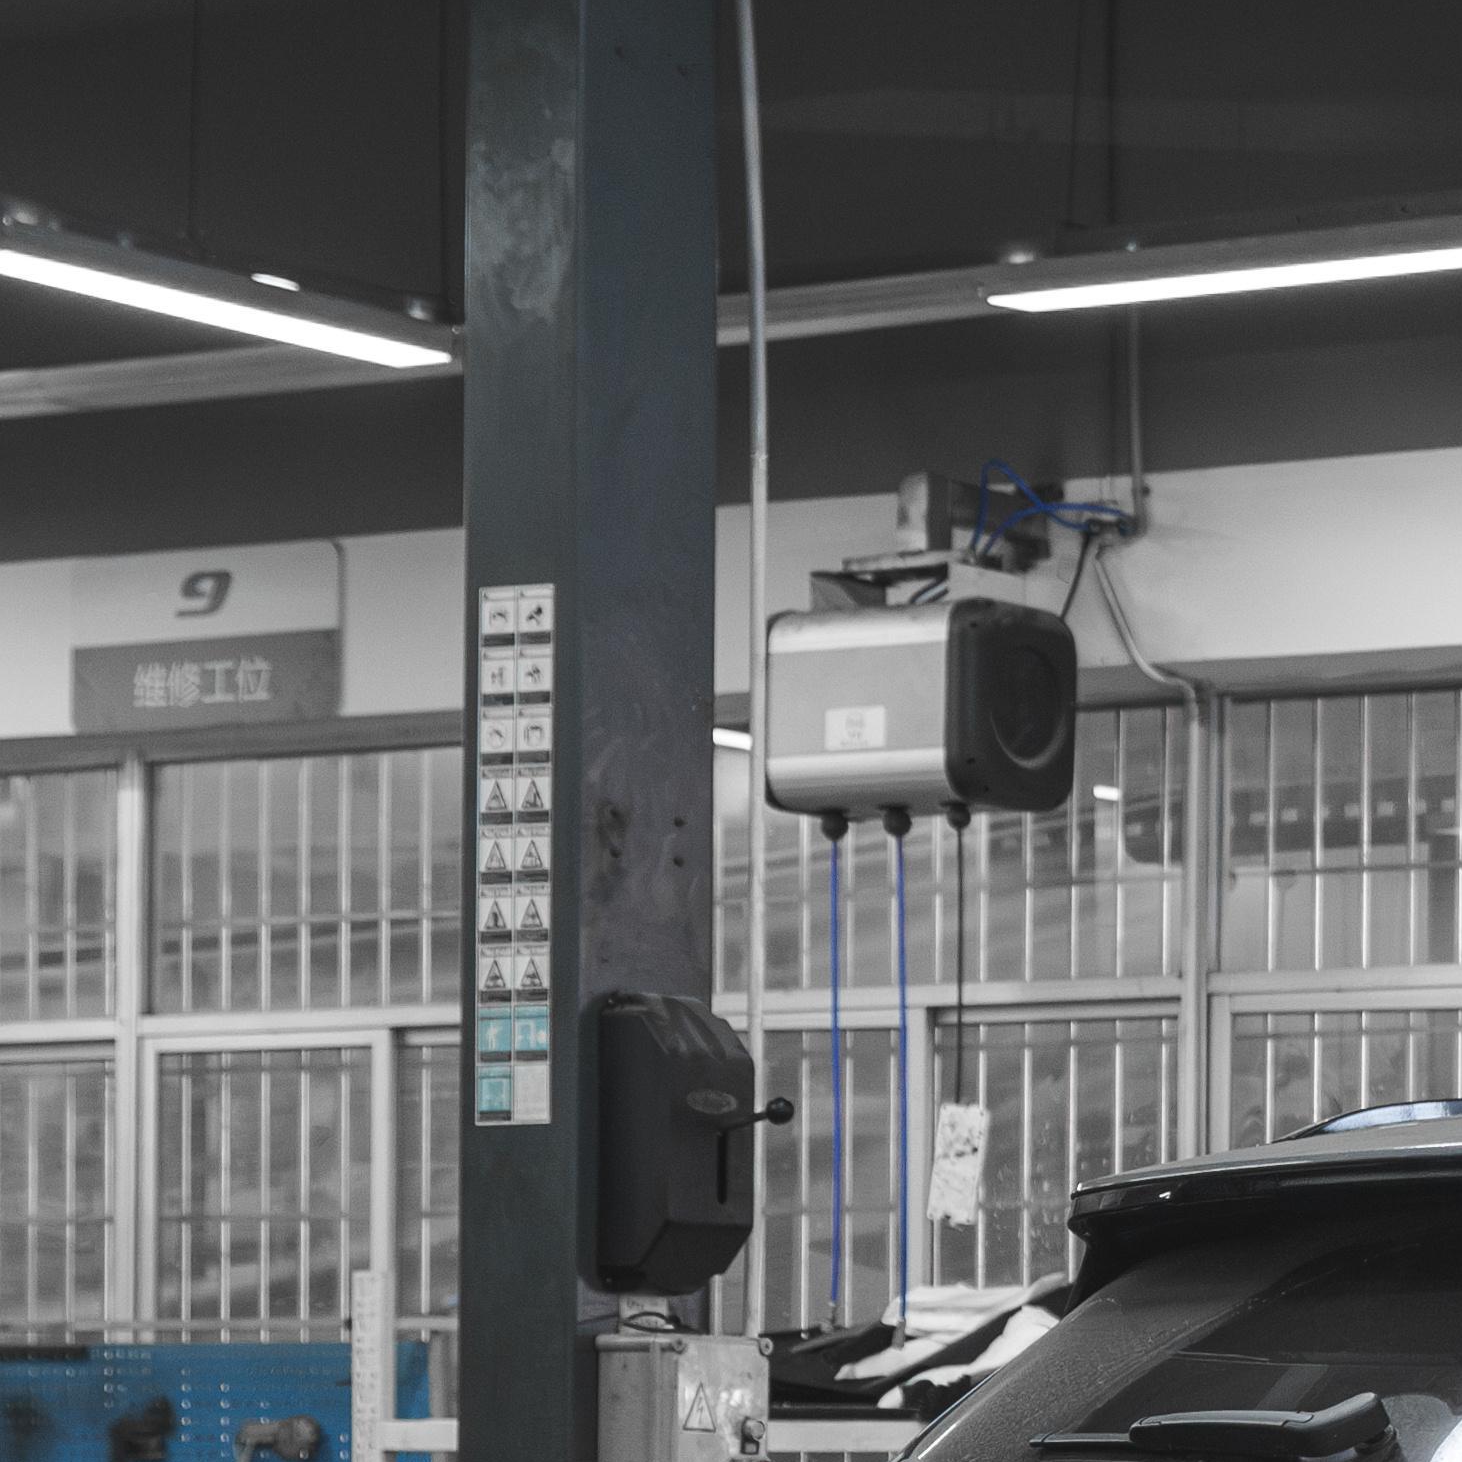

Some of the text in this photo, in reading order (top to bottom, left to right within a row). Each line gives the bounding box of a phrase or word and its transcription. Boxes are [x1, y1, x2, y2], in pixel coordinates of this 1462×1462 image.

[176, 570, 232, 617] 9
[133, 656, 273, 710] 维修工位
